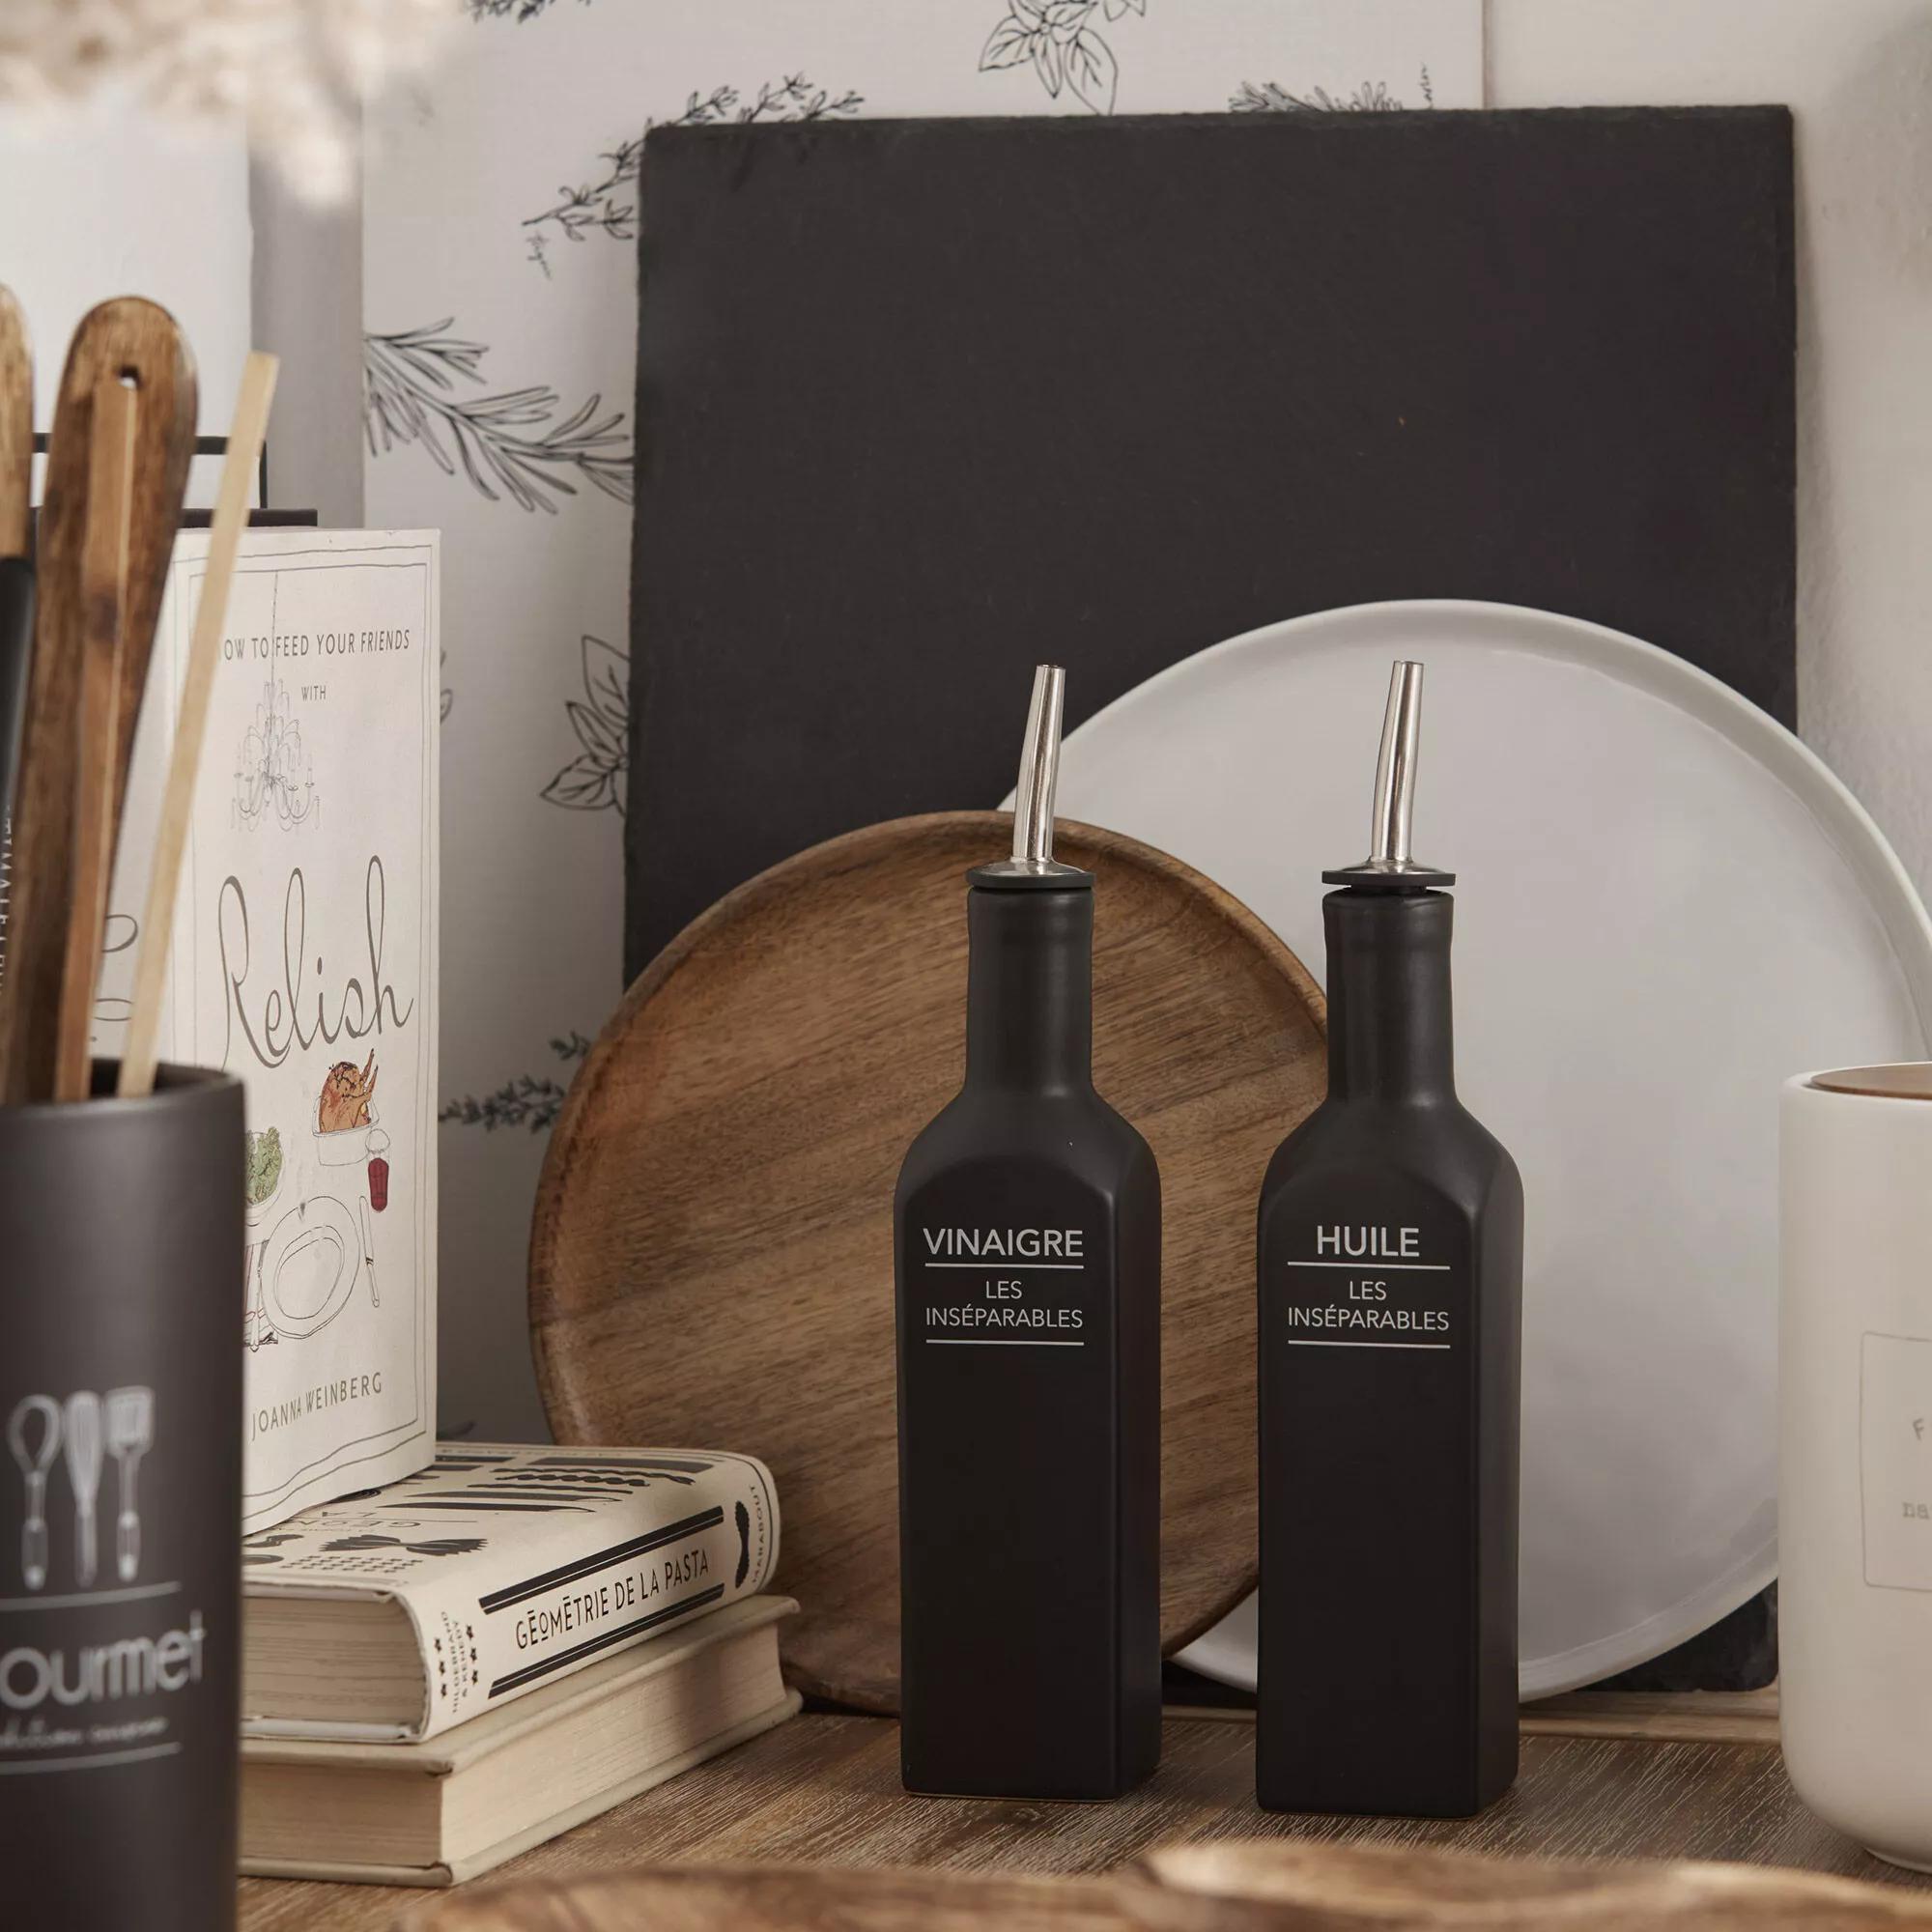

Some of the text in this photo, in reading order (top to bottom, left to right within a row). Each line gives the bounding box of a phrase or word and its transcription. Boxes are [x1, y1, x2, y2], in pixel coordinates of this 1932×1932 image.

[217, 629, 410, 661] OW TO FEED YOUR FRIENDS
[301, 685, 327, 701] WITH
[218, 855, 413, 1070] Relish
[923, 1228, 1084, 1257] VINAIGRE
[1317, 1225, 1420, 1257] HUILE
[985, 1280, 1022, 1299] LES
[1350, 1280, 1387, 1300] LES
[926, 1303, 1084, 1328] INSÉPARABLES
[1288, 1304, 1450, 1331] INSÉPARABLES
[251, 1372, 382, 1441] JOANNA WEINBERG
[614, 1577, 635, 1610] DE
[639, 1569, 660, 1600] LA
[664, 1549, 709, 1590] PASTA
[0, 1609, 206, 1709] ourmet
